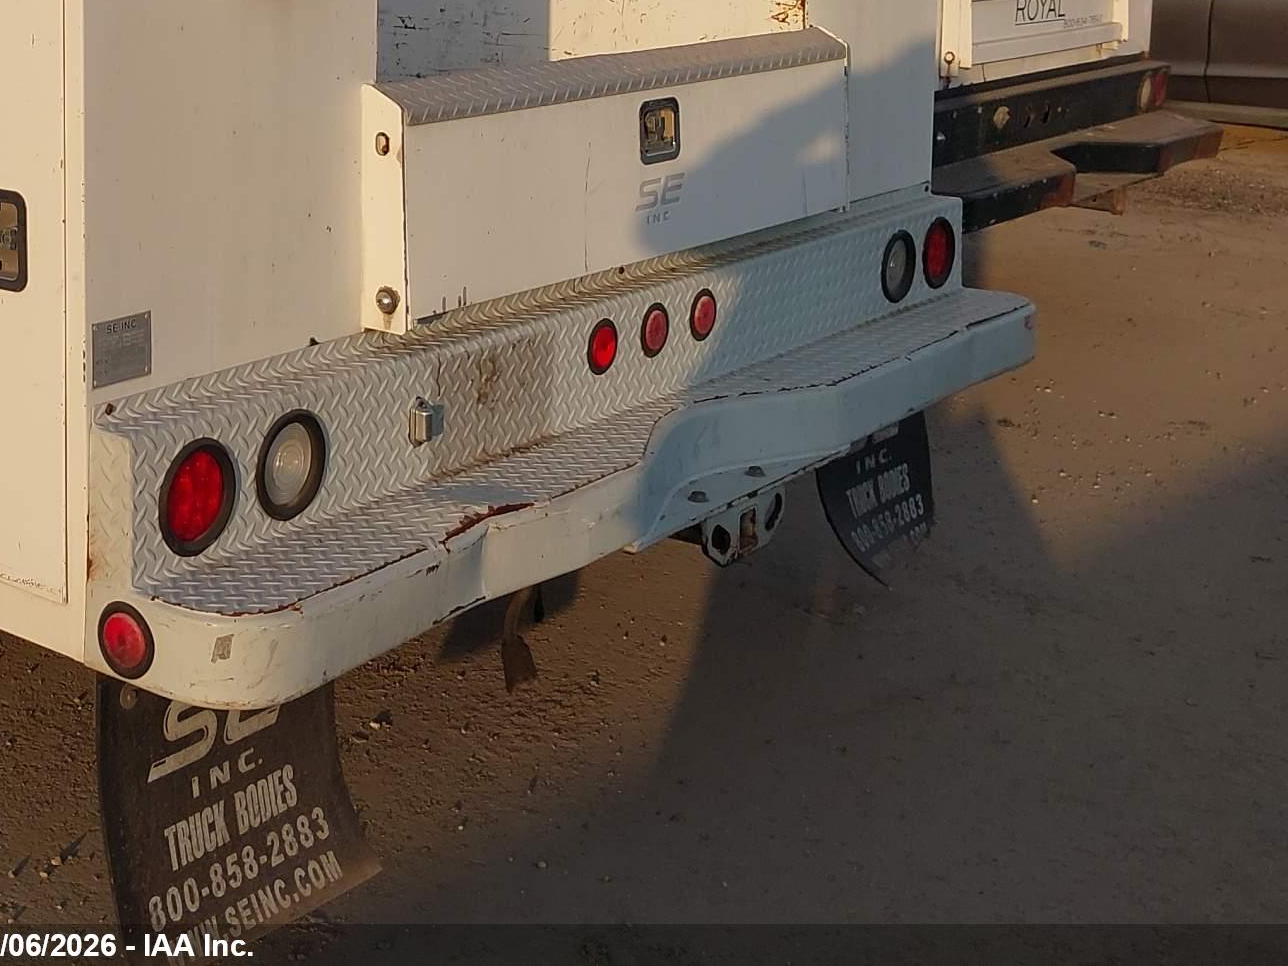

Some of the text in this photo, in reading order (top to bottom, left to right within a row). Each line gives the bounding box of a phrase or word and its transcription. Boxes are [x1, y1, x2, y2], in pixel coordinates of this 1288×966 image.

[635, 172, 685, 211] SE
[106, 318, 137, 334] SE INC
[191, 747, 263, 799] INC.
[164, 764, 298, 872] TRUCK BODIES
[148, 806, 330, 933] 800-858-2883
